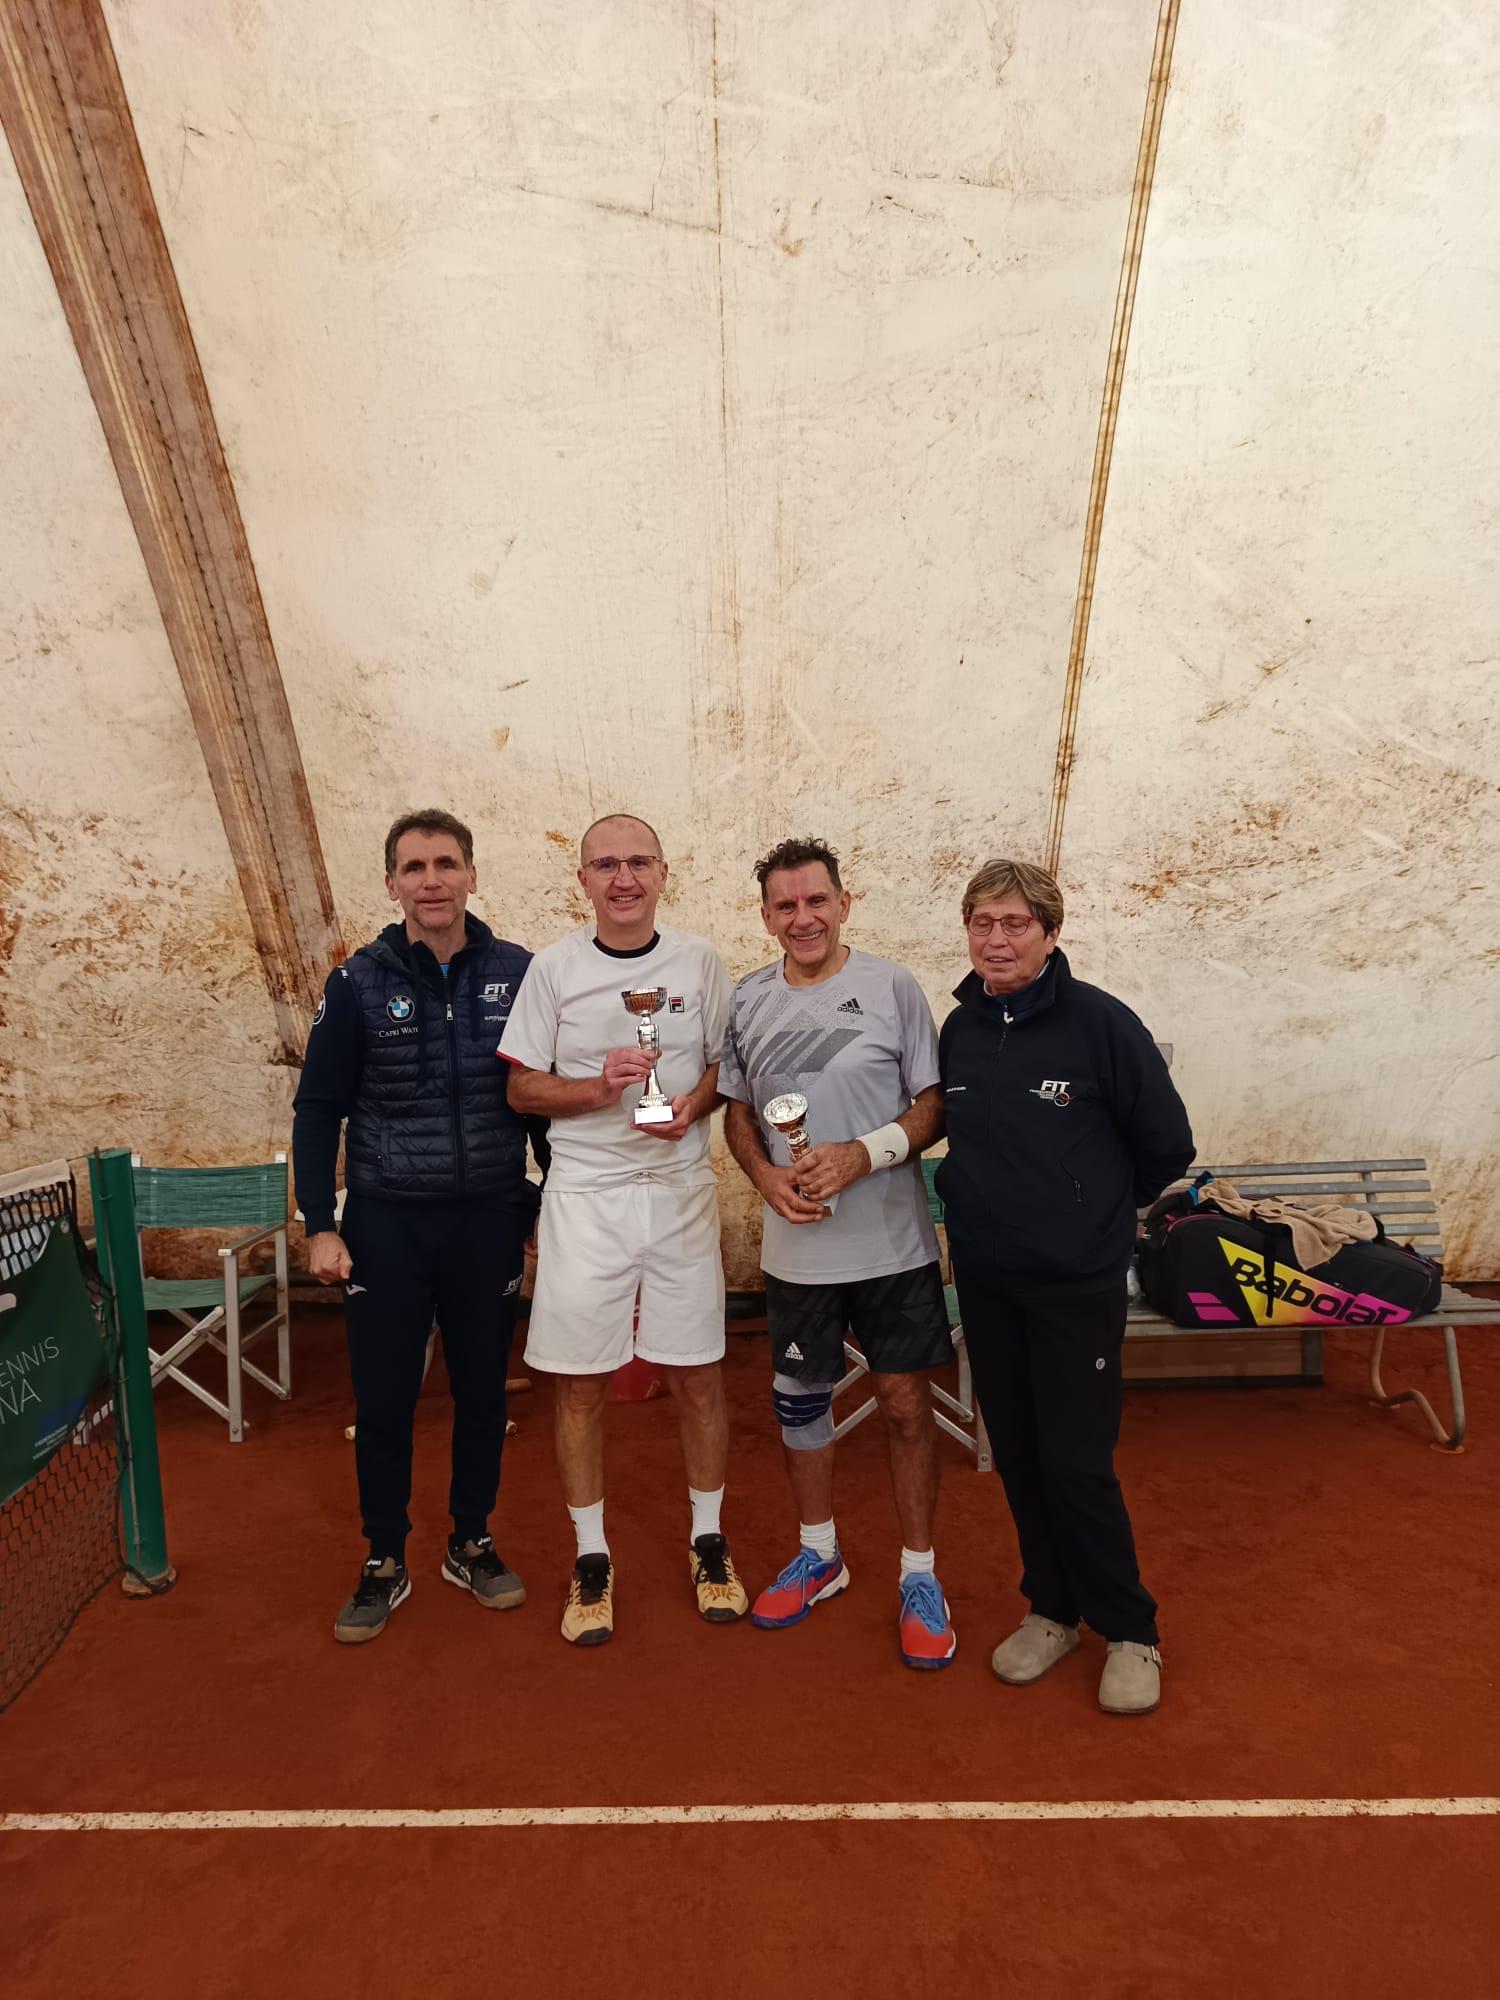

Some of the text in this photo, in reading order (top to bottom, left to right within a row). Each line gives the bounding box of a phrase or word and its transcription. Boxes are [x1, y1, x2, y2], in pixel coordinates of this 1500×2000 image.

[484, 983, 509, 994] FIT
[837, 1006, 864, 1016] adidas
[1040, 1079, 1070, 1093] FIT
